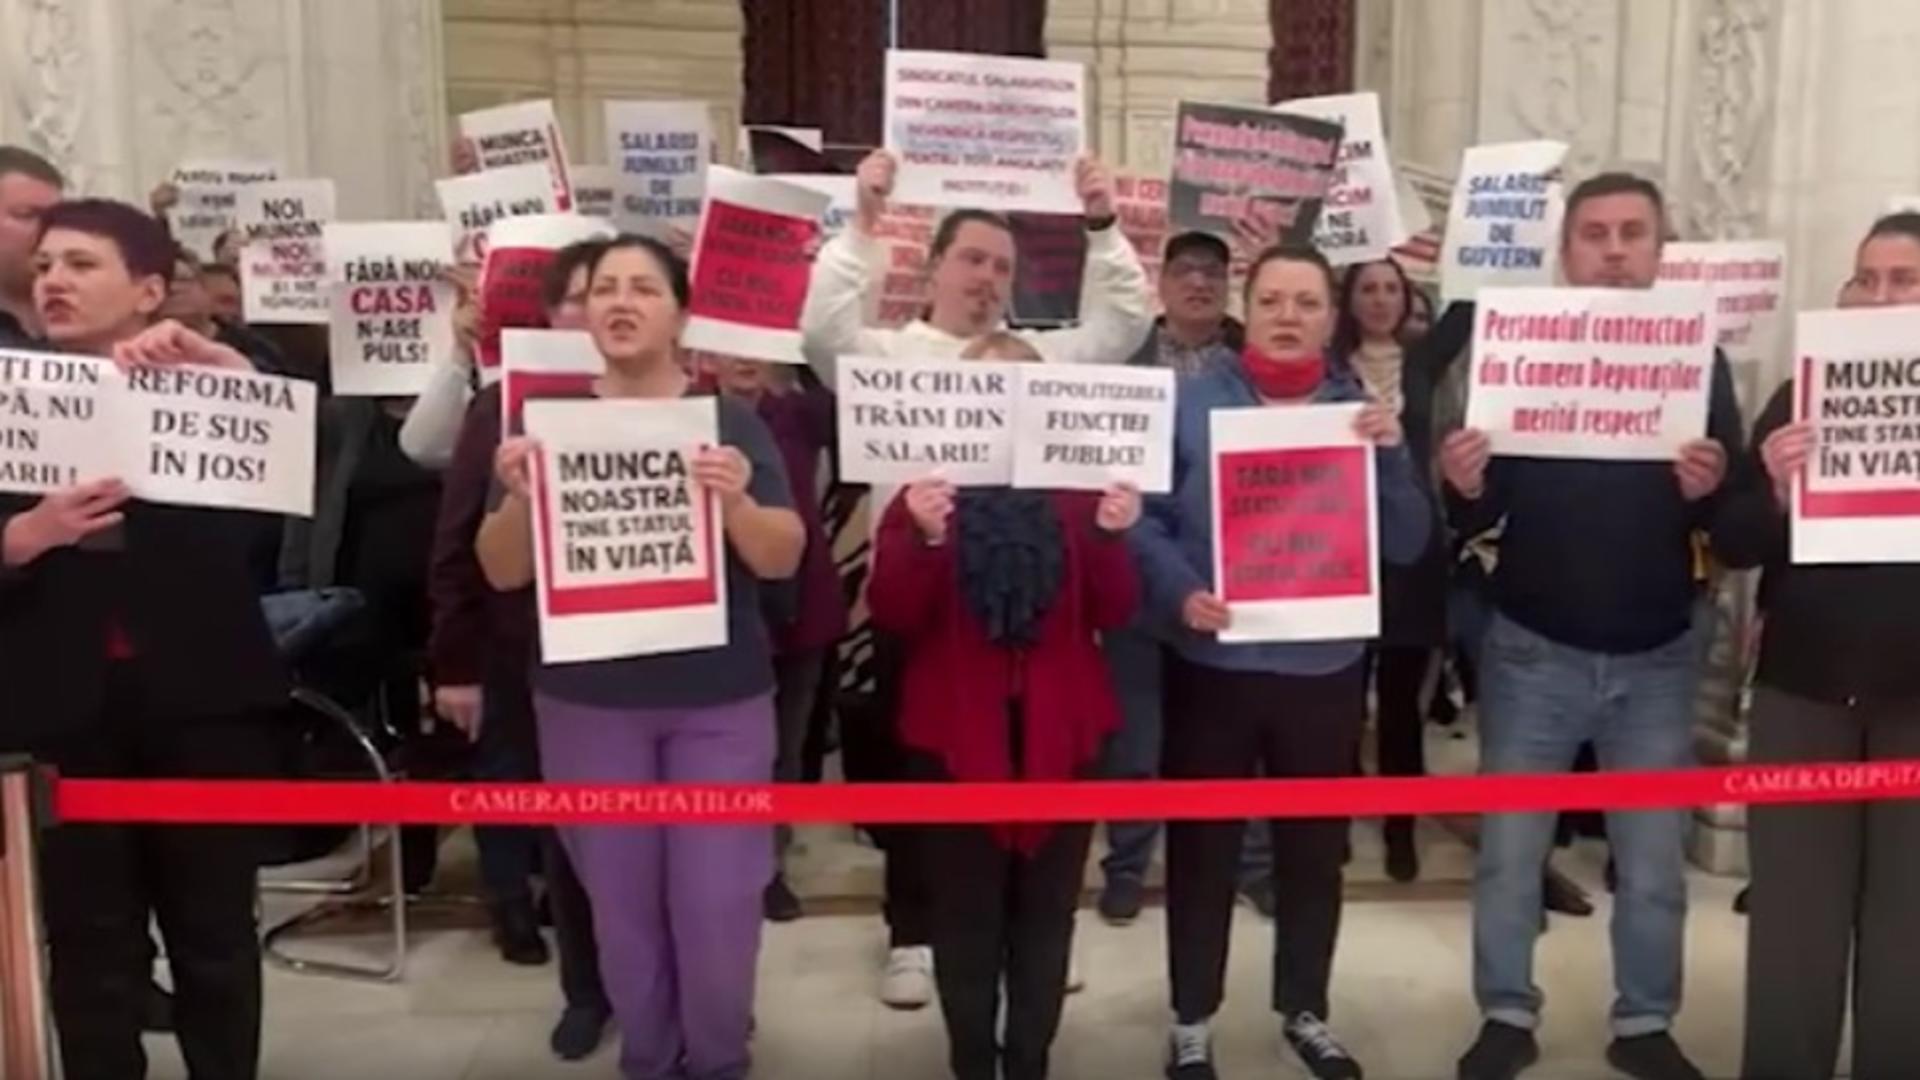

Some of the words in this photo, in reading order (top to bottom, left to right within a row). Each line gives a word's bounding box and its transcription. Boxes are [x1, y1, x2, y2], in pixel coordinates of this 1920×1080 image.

[895, 96, 922, 109] DIN
[480, 130, 544, 150] MUNCA
[649, 179, 672, 195] DE
[262, 197, 305, 219] NOI
[1488, 222, 1515, 244] DE
[345, 255, 399, 282] FĂRĂ
[1458, 245, 1545, 268] GUVERN
[351, 284, 437, 314] CASA
[357, 318, 421, 340] N-ARE
[1484, 309, 1588, 341] Personalul
[1592, 311, 1704, 345] contractual
[362, 342, 429, 364] PULS!
[43, 359, 99, 385] DIN
[851, 368, 904, 394] NOI
[909, 370, 1006, 396] CHIAR
[1479, 352, 1508, 387] din
[1514, 356, 1585, 388] Camera
[1028, 379, 1168, 402] DEPOLITIZAREA
[48, 394, 95, 421] NU
[852, 399, 945, 428] TRĂIM
[955, 406, 1005, 428] DIN
[1513, 401, 1578, 434] merită
[1583, 404, 1662, 438] respect!
[0, 427, 40, 451] IN
[151, 408, 201, 437] DE
[208, 413, 273, 446] SUS
[1874, 423, 1920, 443] STA
[149, 442, 187, 476] ÎN
[198, 451, 268, 483] JOS!
[865, 441, 991, 464] SALARII!
[1043, 443, 1145, 467] PUBLICE!
[1820, 445, 1852, 477] ÎN
[558, 450, 688, 482] MUNCA
[561, 479, 692, 513] NOASTRĂ
[617, 513, 693, 537] STATUL
[566, 541, 597, 573] ÎN
[605, 534, 697, 574] VIAȚĂ
[1723, 768, 1830, 795] CAMERA
[450, 789, 575, 813] CAMERA
